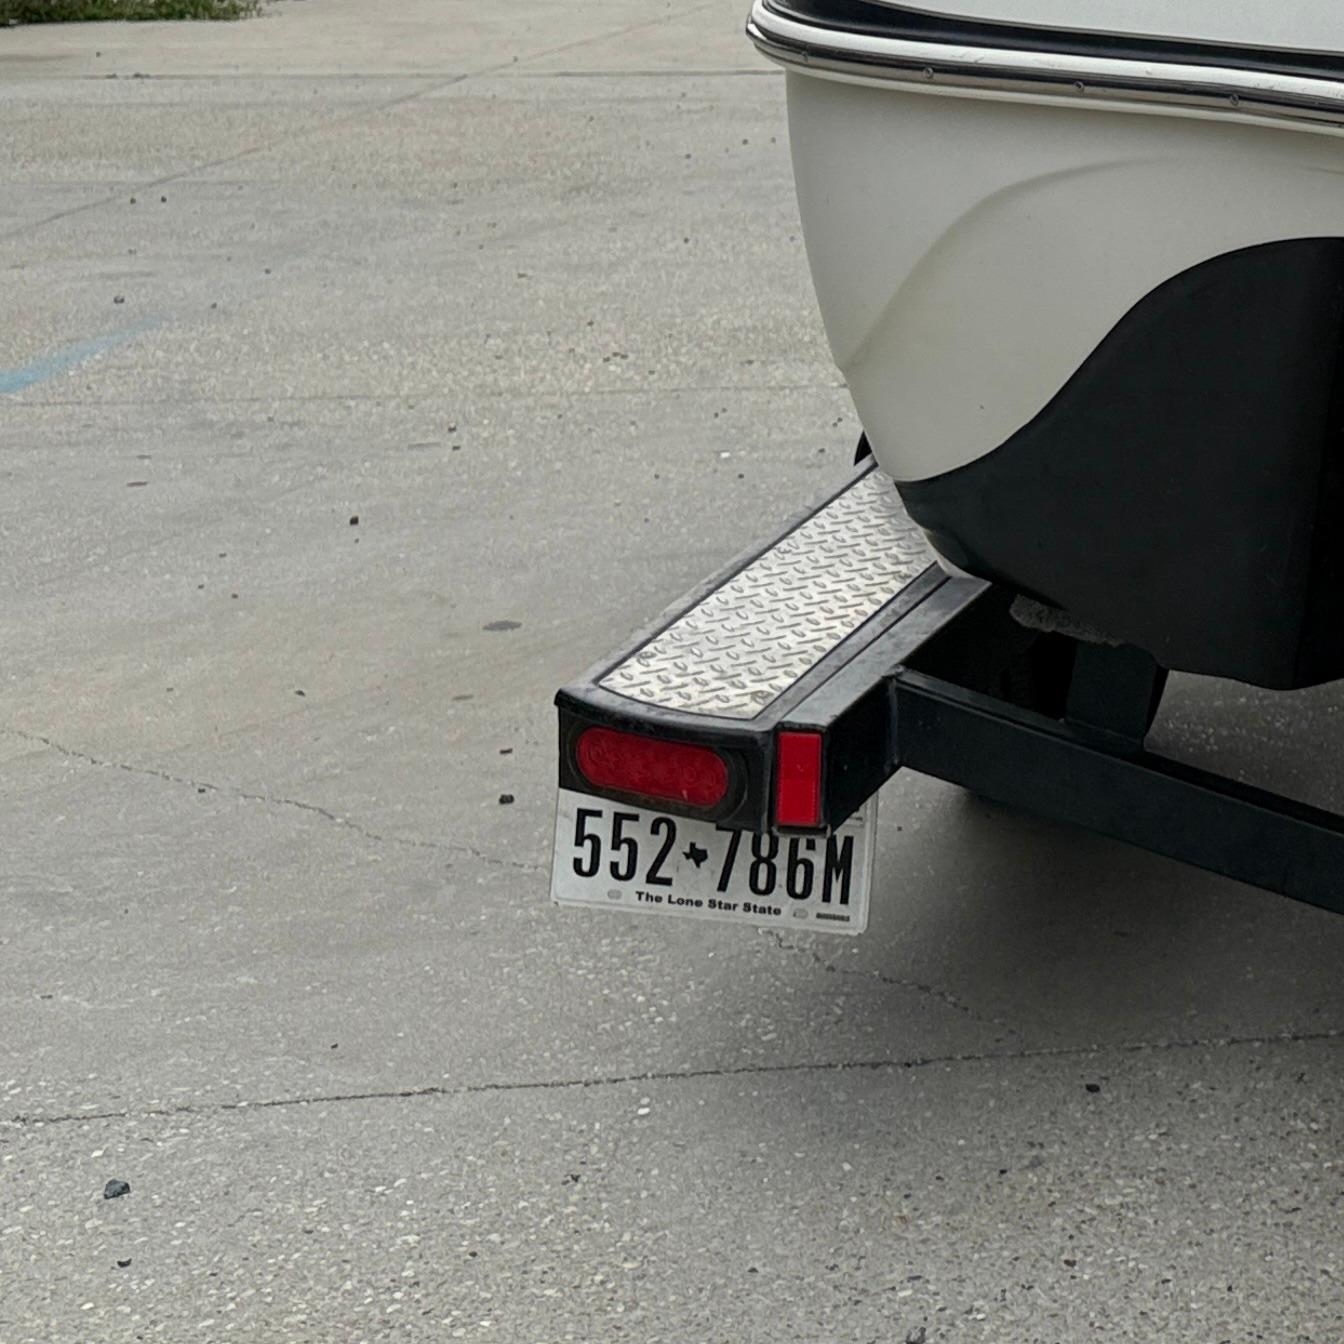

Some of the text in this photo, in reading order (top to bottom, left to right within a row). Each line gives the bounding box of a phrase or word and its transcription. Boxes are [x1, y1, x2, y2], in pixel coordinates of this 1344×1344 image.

[635, 890, 782, 916] The Lone Star State
